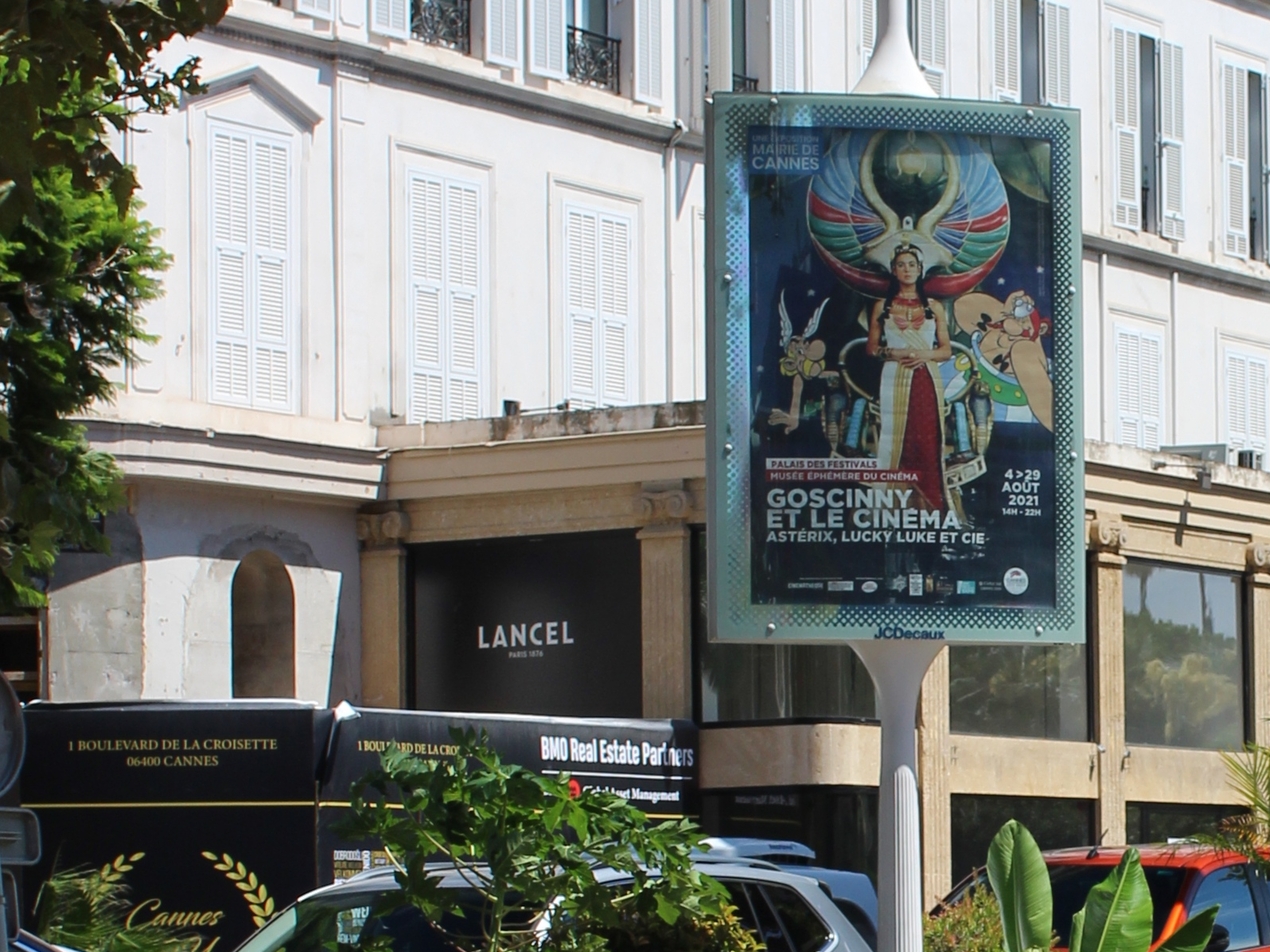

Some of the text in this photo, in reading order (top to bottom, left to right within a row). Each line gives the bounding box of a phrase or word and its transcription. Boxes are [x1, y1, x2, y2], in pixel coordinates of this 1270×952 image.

[802, 144, 819, 156] DE
[752, 156, 820, 170] CANNES
[771, 460, 877, 469] PALAIS DES FESTIVALS
[770, 471, 918, 482] MUSÉE ÉPHÉMÈRE DU CINÉMA
[1001, 480, 1040, 493] AOÛT
[766, 488, 913, 508] GOSCINNY
[1008, 494, 1039, 506] 2021
[767, 506, 961, 530] ET LE CINÉMA
[1002, 507, 1018, 516] 14H
[1024, 508, 1041, 516] 22H
[766, 528, 985, 544] ASTÉRIX, LUCKY LUKE ET CIE
[478, 621, 574, 649] LANCEL
[874, 626, 945, 639] JCDecaux
[68, 739, 278, 751] 1 BOULEVARD DE LA CROISETTE
[415, 743, 426, 755] DE
[428, 744, 439, 755] LA
[540, 736, 693, 767] BMO Real Estate Partners
[126, 756, 219, 767] 06400 CANNES
[632, 788, 679, 803] Management
[126, 898, 224, 930] Cannes
